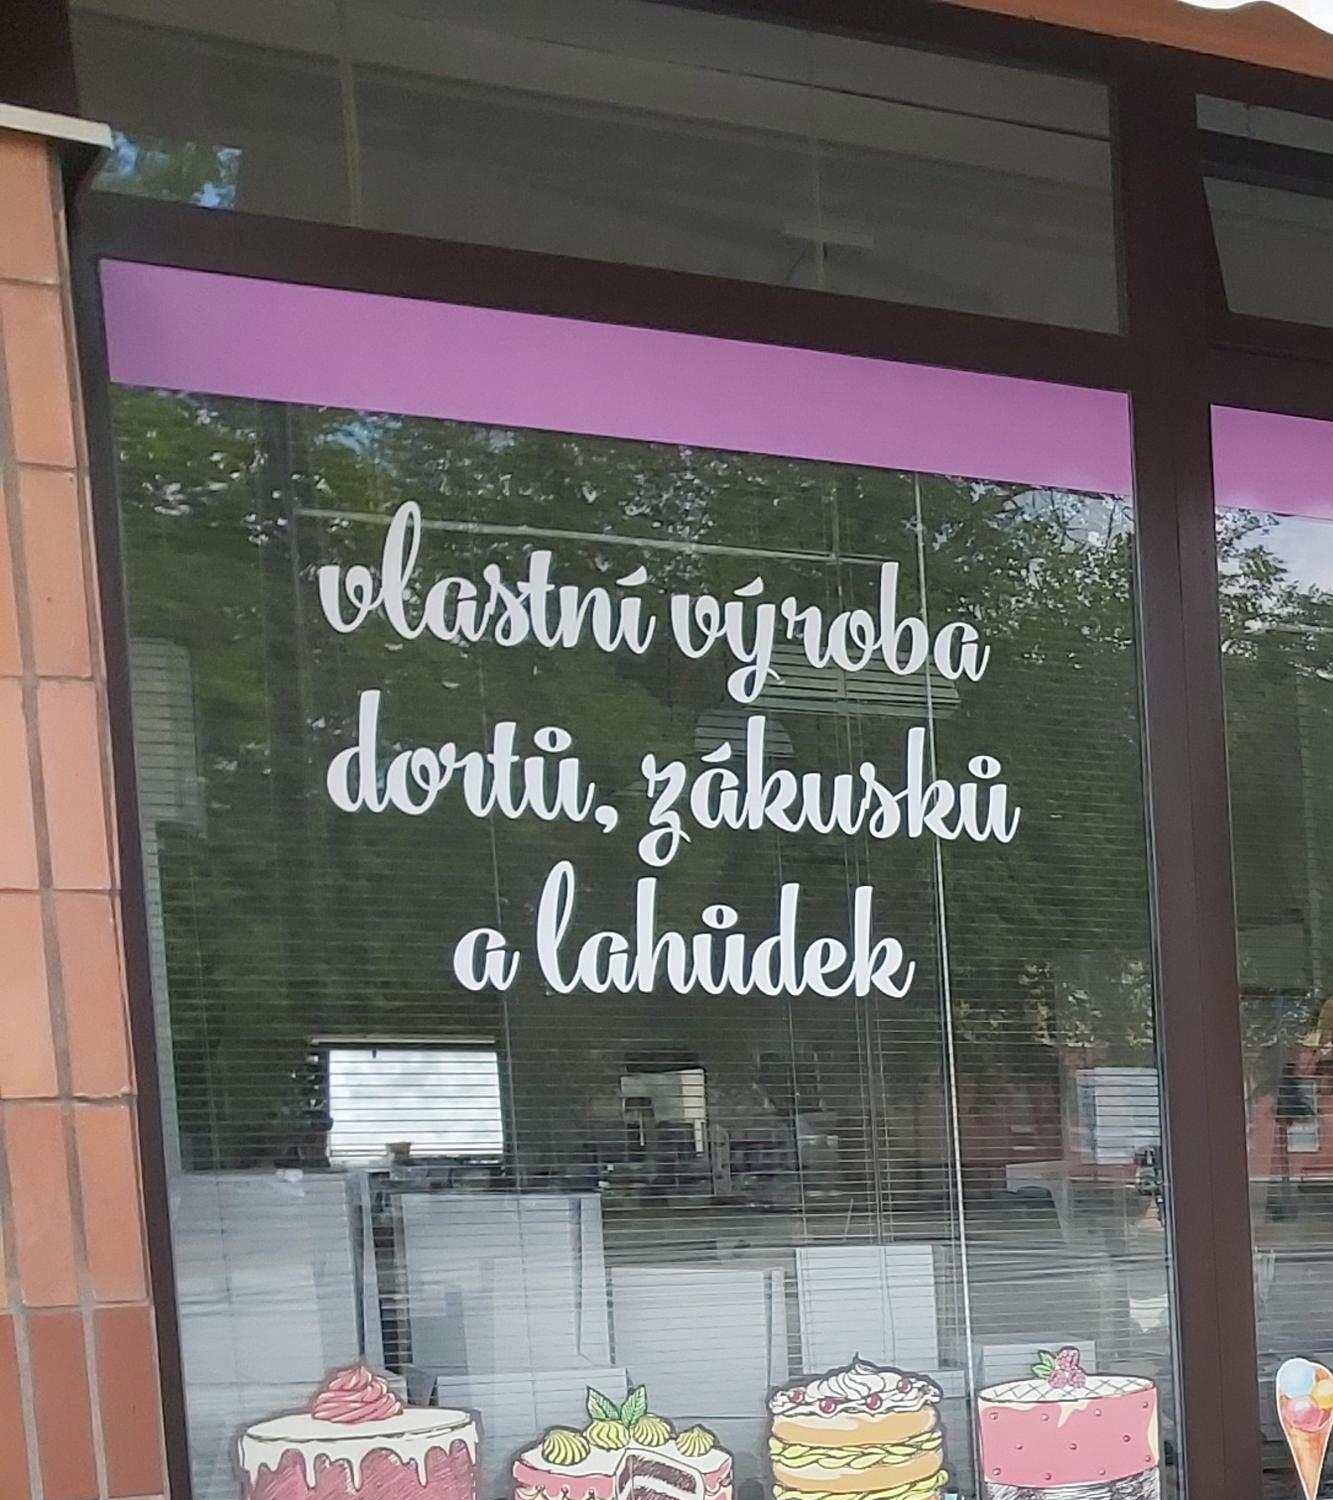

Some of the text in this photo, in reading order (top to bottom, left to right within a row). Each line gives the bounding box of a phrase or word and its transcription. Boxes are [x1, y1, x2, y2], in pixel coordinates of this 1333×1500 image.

[316, 500, 991, 704] vlastní výroba
[326, 689, 1021, 867] dortů, zákusků
[453, 860, 916, 999] a lahůdek
